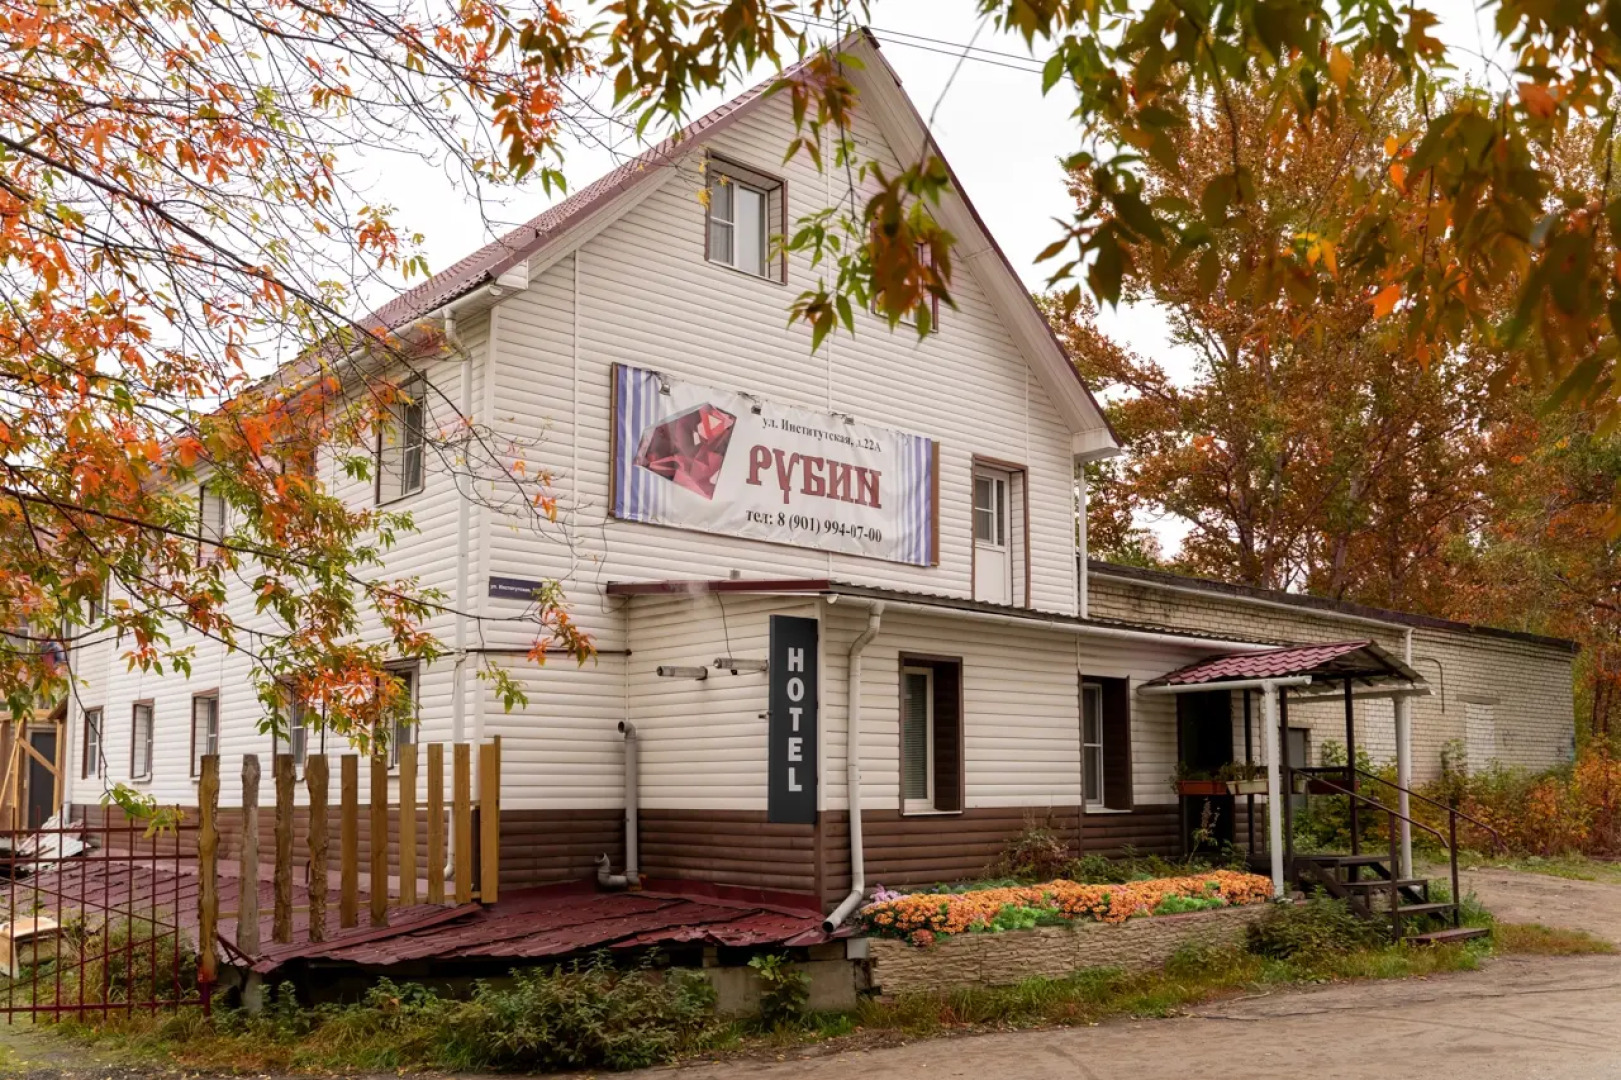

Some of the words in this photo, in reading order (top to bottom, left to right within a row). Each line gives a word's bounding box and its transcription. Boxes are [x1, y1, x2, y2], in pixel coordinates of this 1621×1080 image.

[762, 417, 778, 429] ул.
[781, 418, 854, 446] Институтская,
[745, 509, 773, 525] тел:
[777, 511, 786, 527] 8
[788, 514, 821, 535] (901)
[824, 519, 882, 543] 994-07-00
[787, 646, 805, 793] HOTEL
